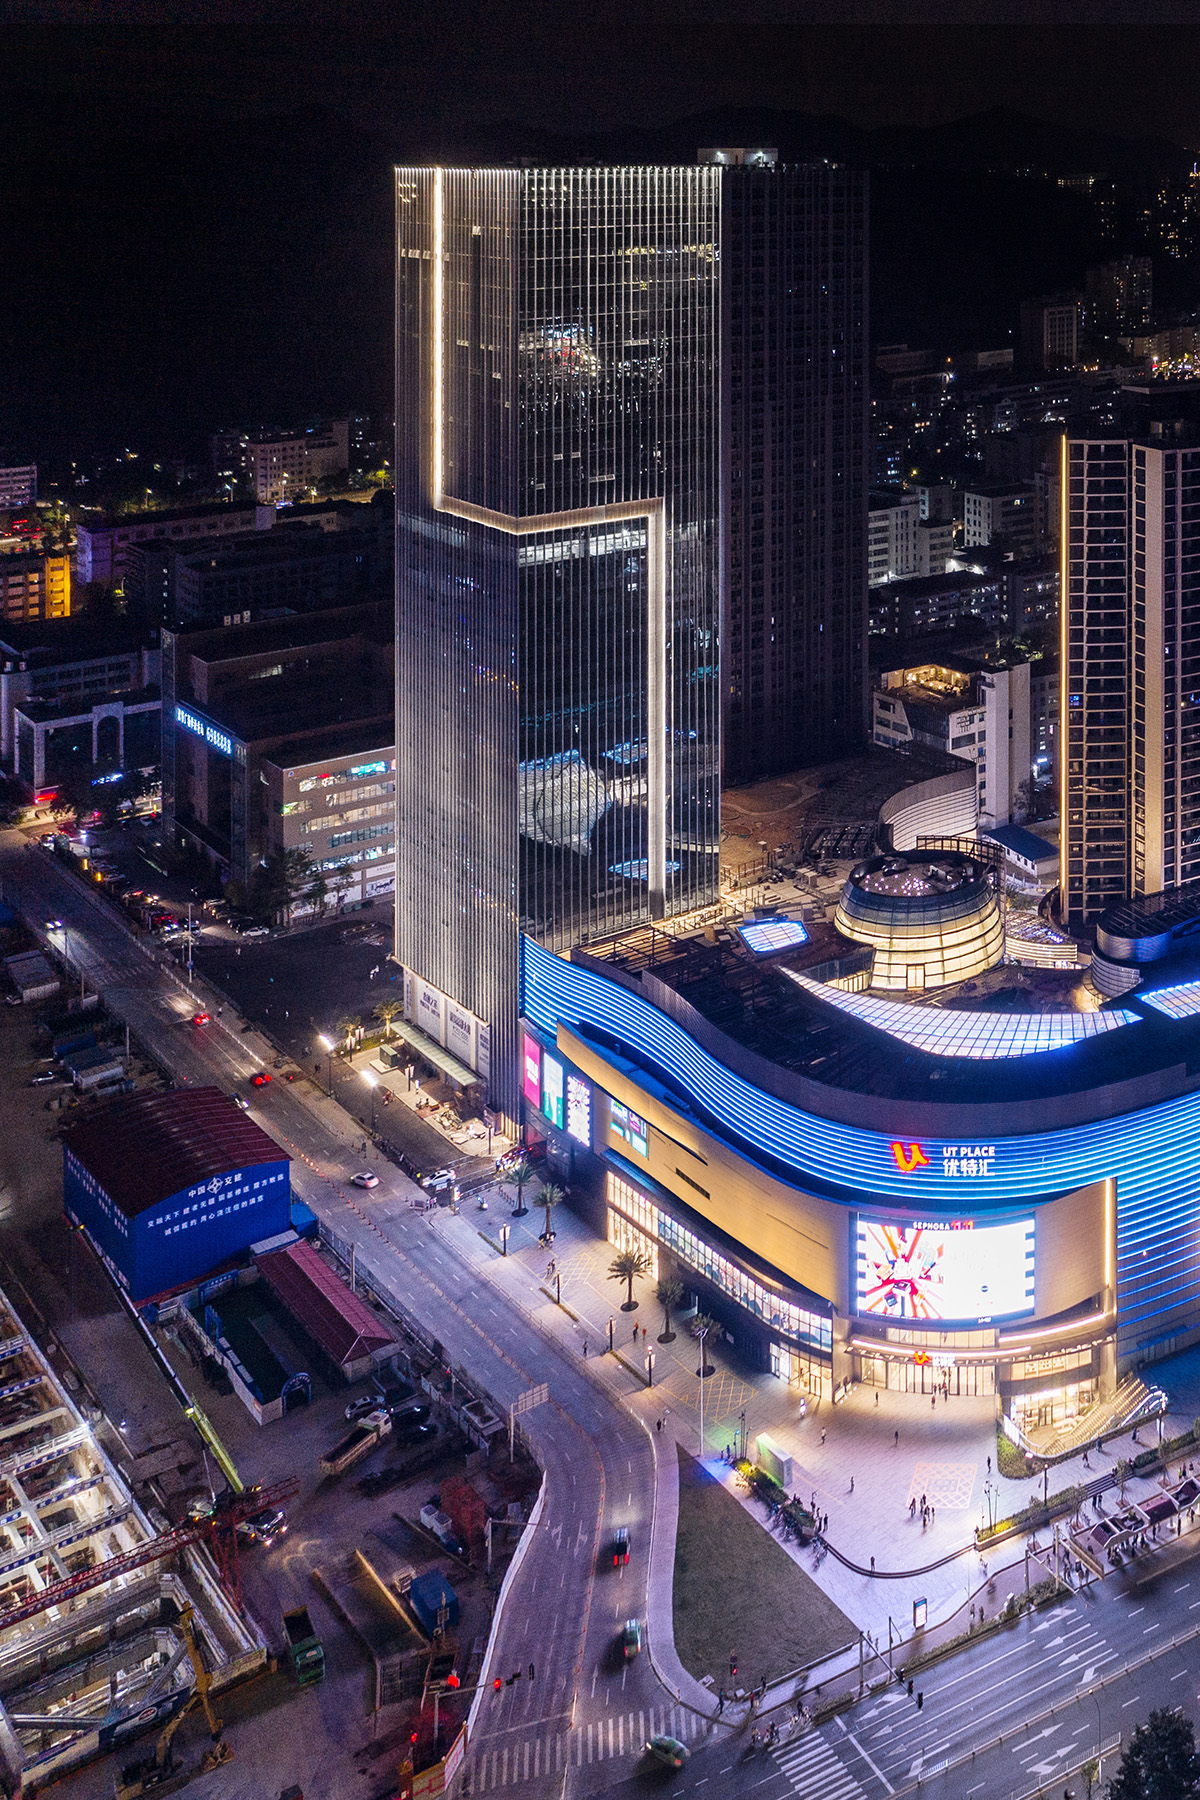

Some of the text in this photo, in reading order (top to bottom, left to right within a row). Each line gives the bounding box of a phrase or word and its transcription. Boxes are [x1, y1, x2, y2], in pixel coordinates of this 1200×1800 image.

[942, 1146, 996, 1157] UT PLACE
[942, 1158, 996, 1177] 优特汇
[188, 1185, 206, 1198] 中国
[912, 1221, 950, 1231] SEPHORA
